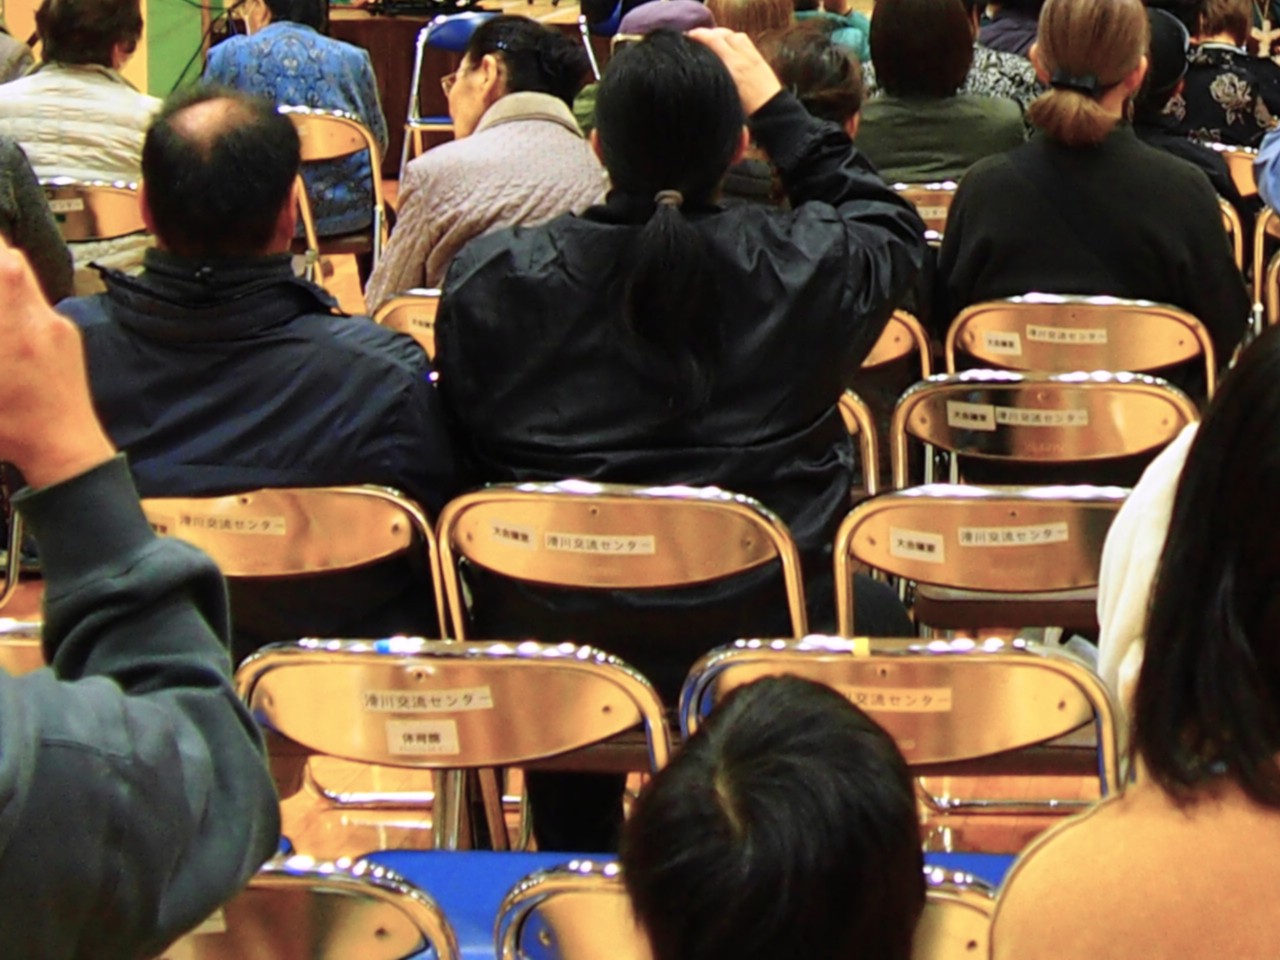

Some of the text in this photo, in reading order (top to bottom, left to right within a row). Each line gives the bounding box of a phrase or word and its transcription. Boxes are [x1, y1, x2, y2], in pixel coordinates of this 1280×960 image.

[847, 691, 950, 708] 交流センター
